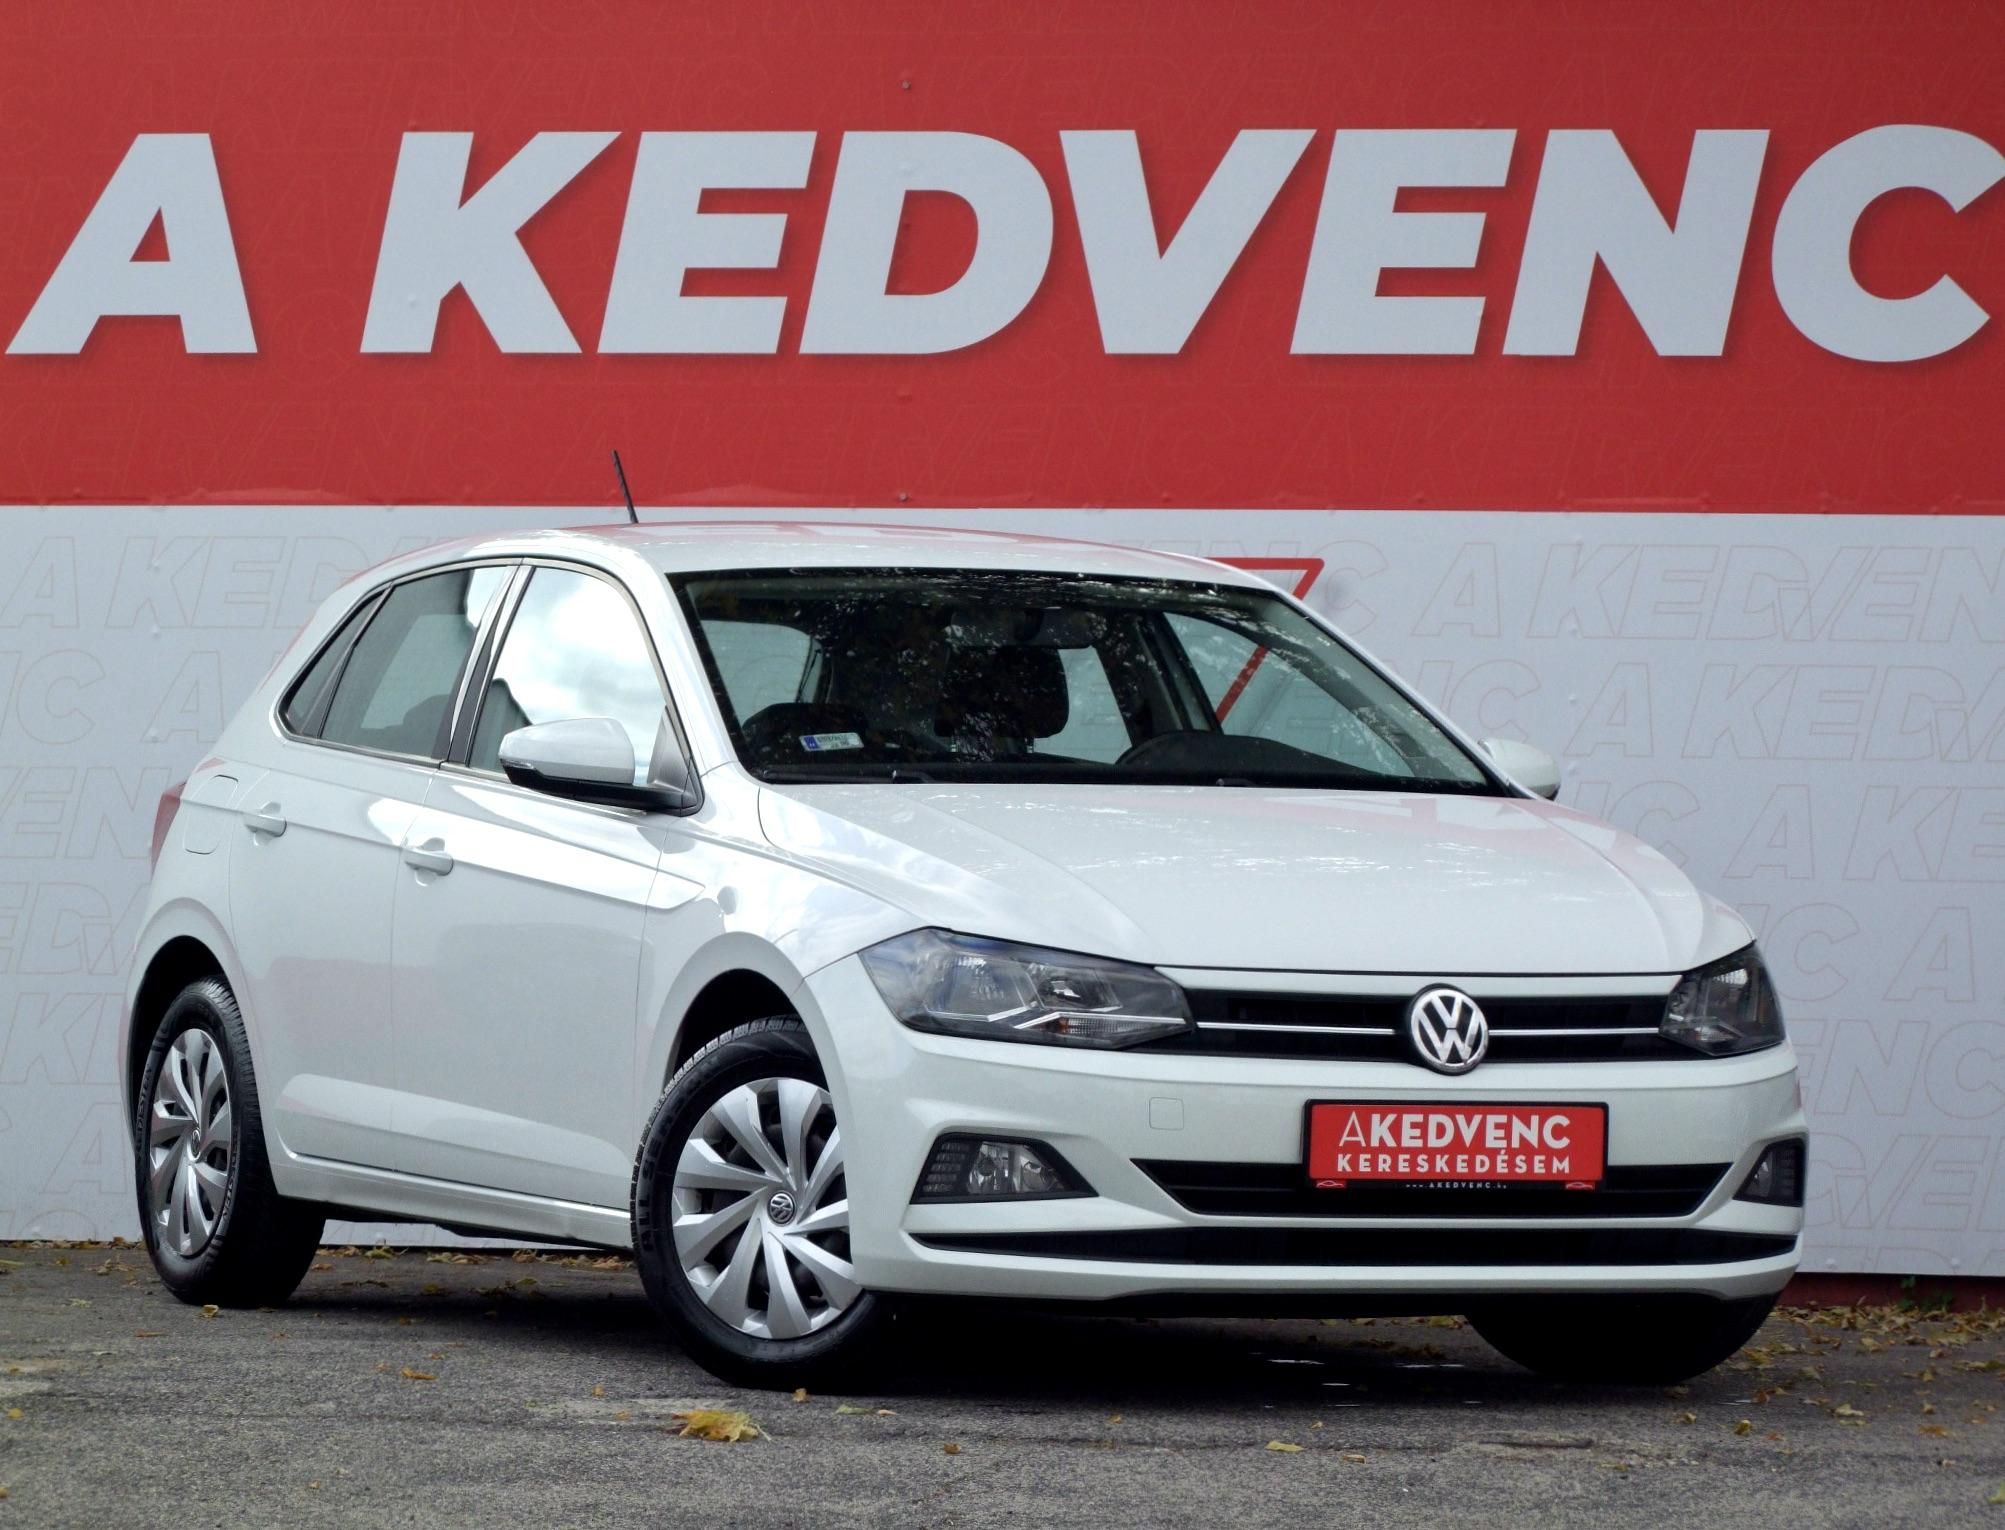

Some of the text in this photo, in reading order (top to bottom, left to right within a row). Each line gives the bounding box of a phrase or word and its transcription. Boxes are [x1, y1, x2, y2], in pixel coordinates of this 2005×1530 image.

[6, 132, 258, 355] A
[360, 124, 2005, 362] KEDVENC
[1337, 1150, 1570, 1174] KERESKEDÉSEM
